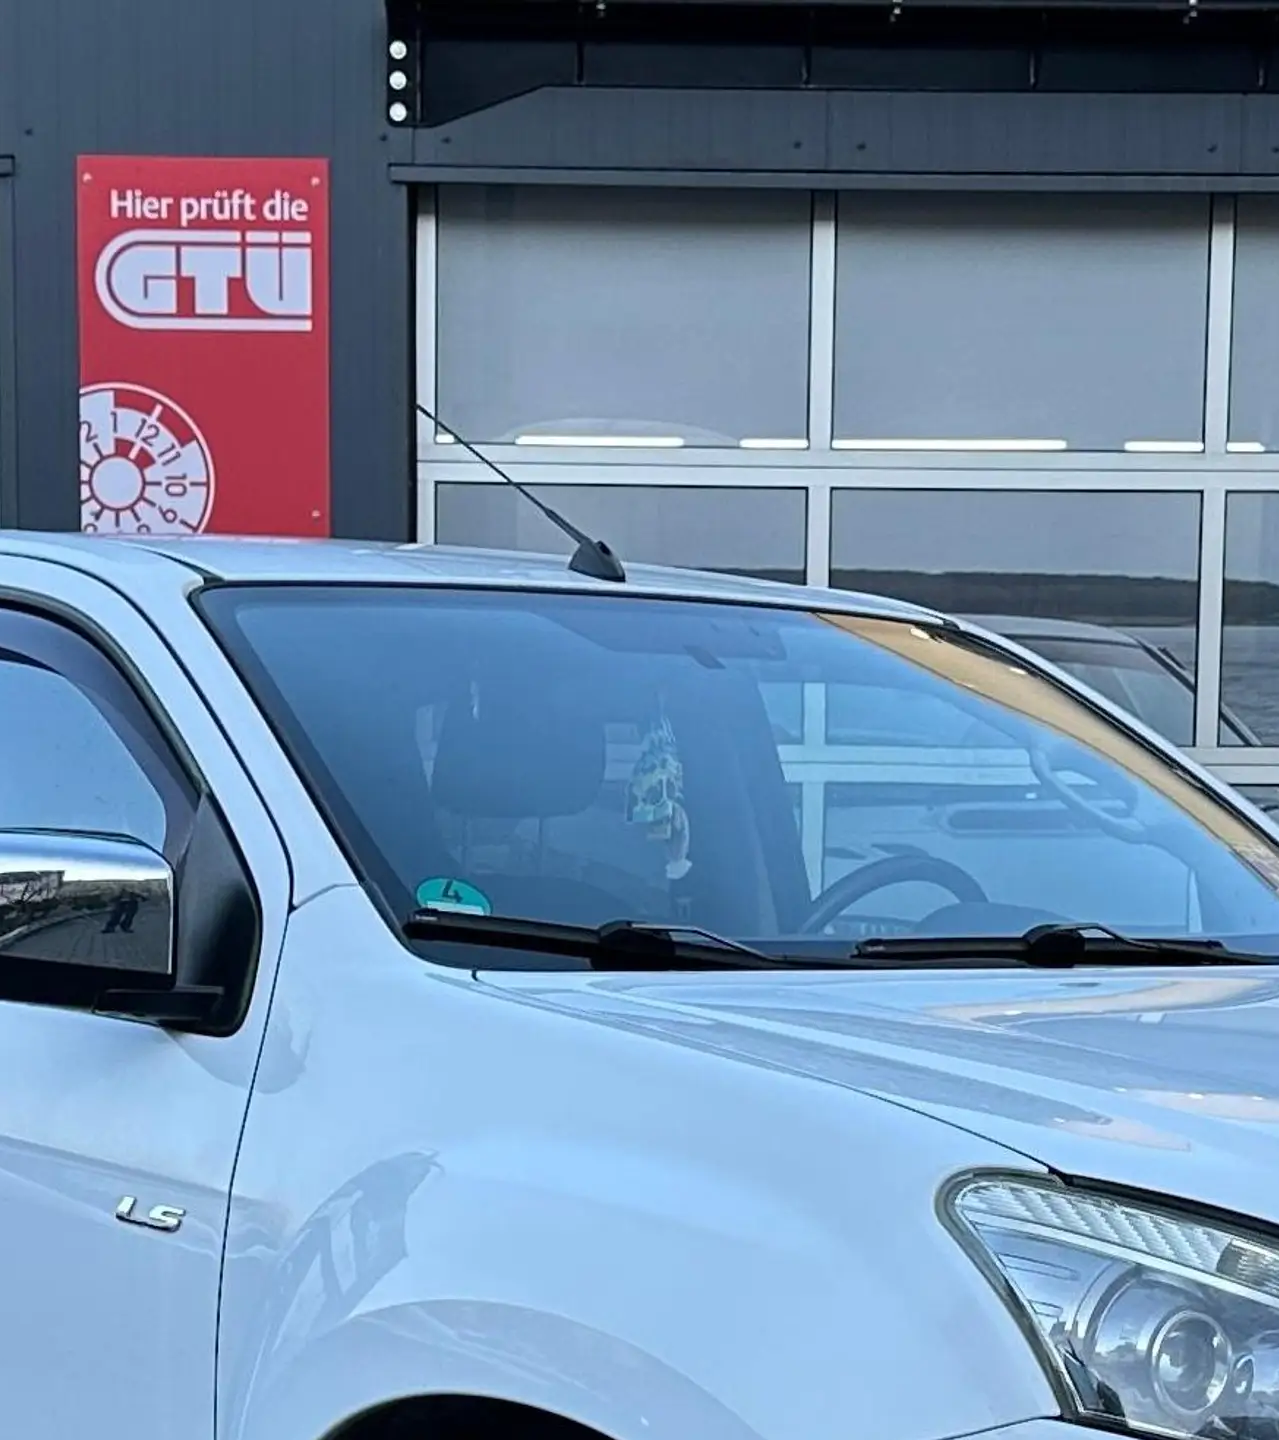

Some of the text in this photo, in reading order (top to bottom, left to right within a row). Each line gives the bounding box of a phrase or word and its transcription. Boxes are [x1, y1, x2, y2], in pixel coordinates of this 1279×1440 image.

[110, 189, 309, 226] Hier prüft die
[105, 230, 313, 318] GTÜ
[134, 417, 161, 448] 12
[157, 442, 182, 467] 11
[164, 472, 188, 497] 10
[441, 879, 464, 904] 4
[115, 1195, 186, 1233] LS
